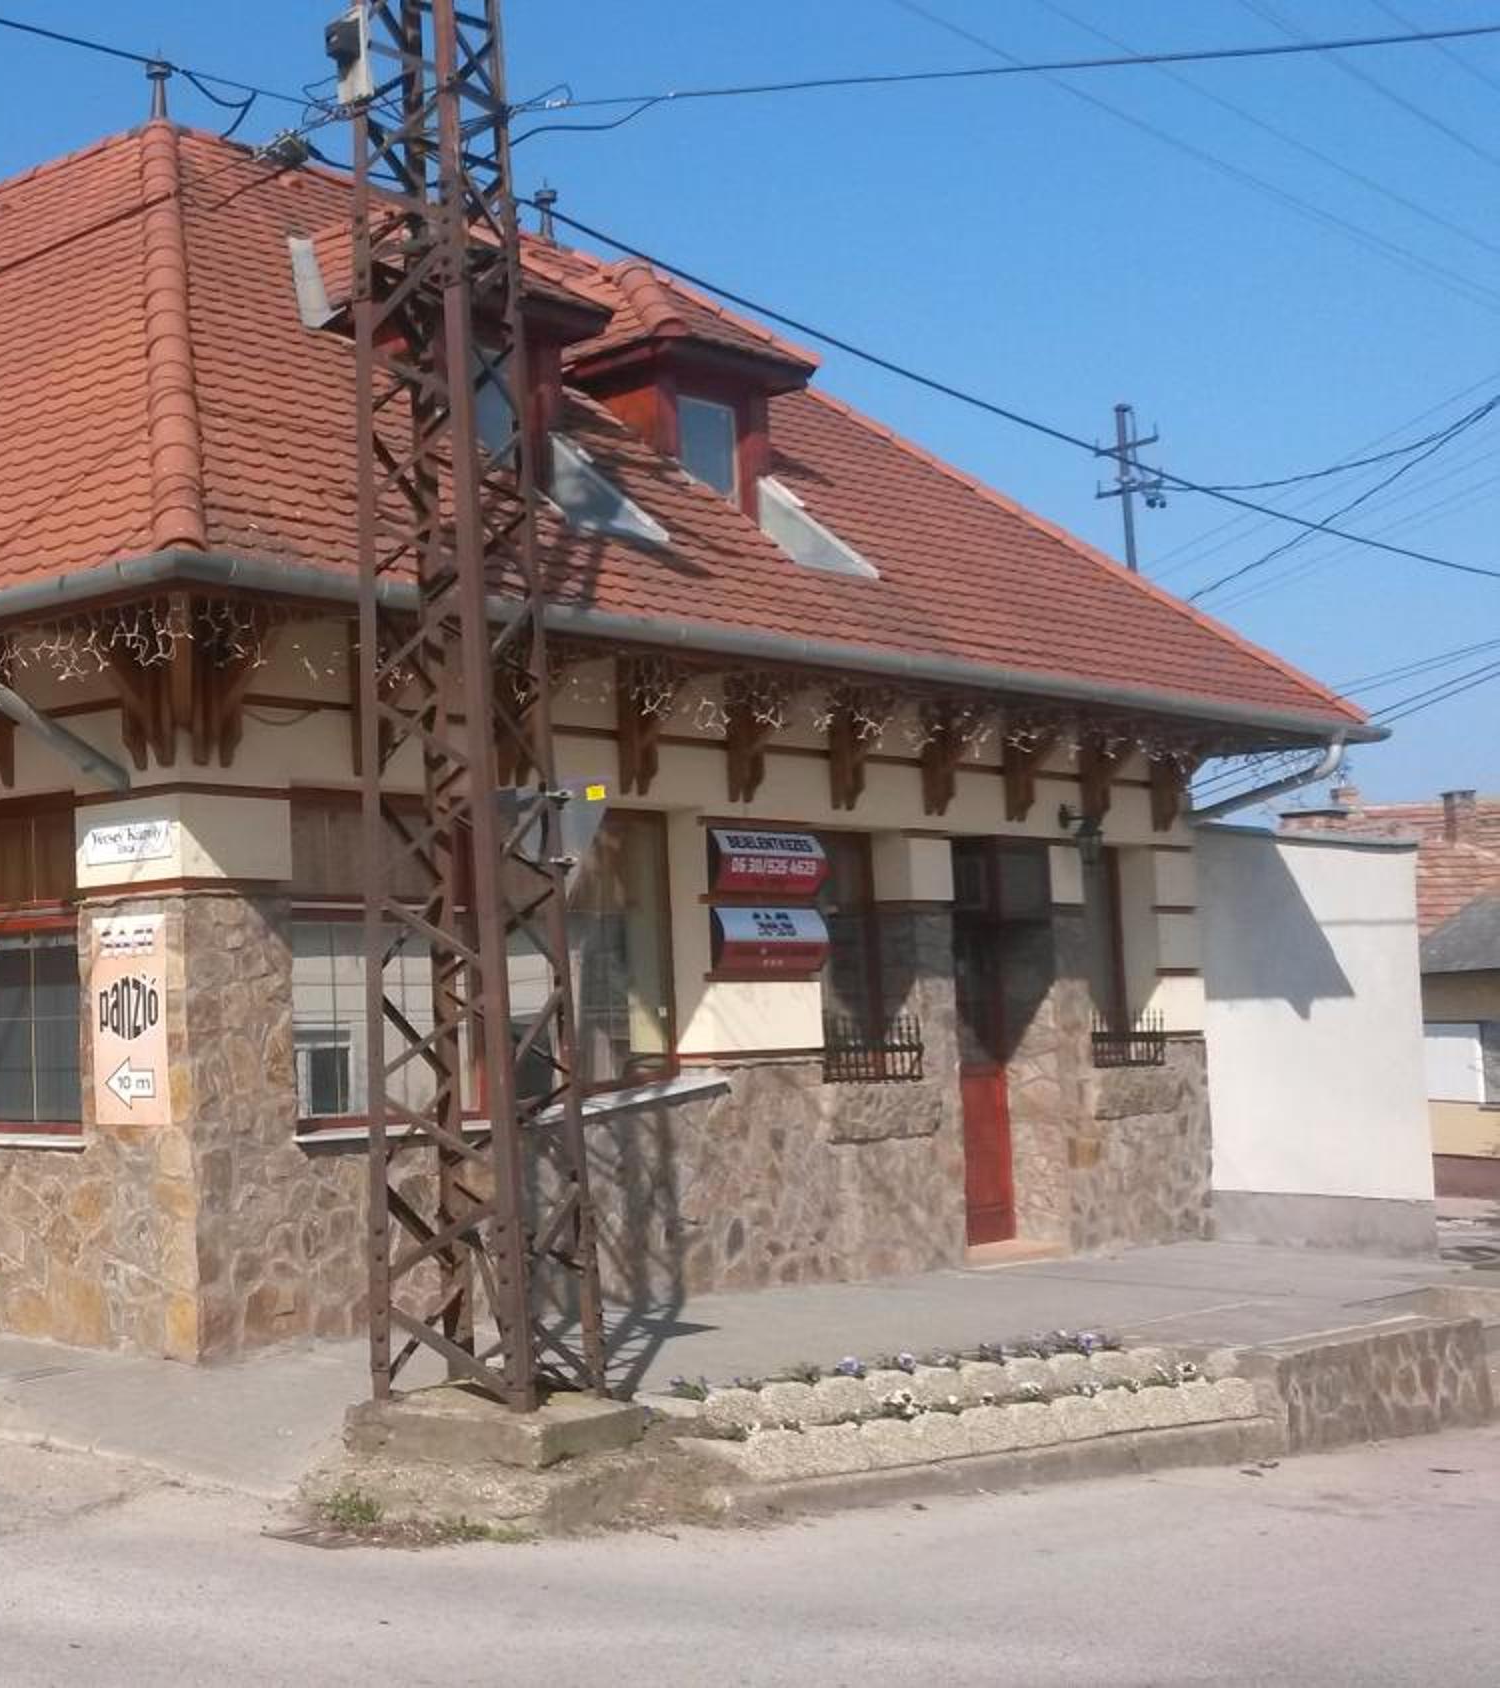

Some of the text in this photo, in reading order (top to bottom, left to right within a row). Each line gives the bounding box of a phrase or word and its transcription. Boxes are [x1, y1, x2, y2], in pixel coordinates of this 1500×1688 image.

[99, 973, 159, 1041] panzió
[118, 1075, 151, 1090] 10 m
